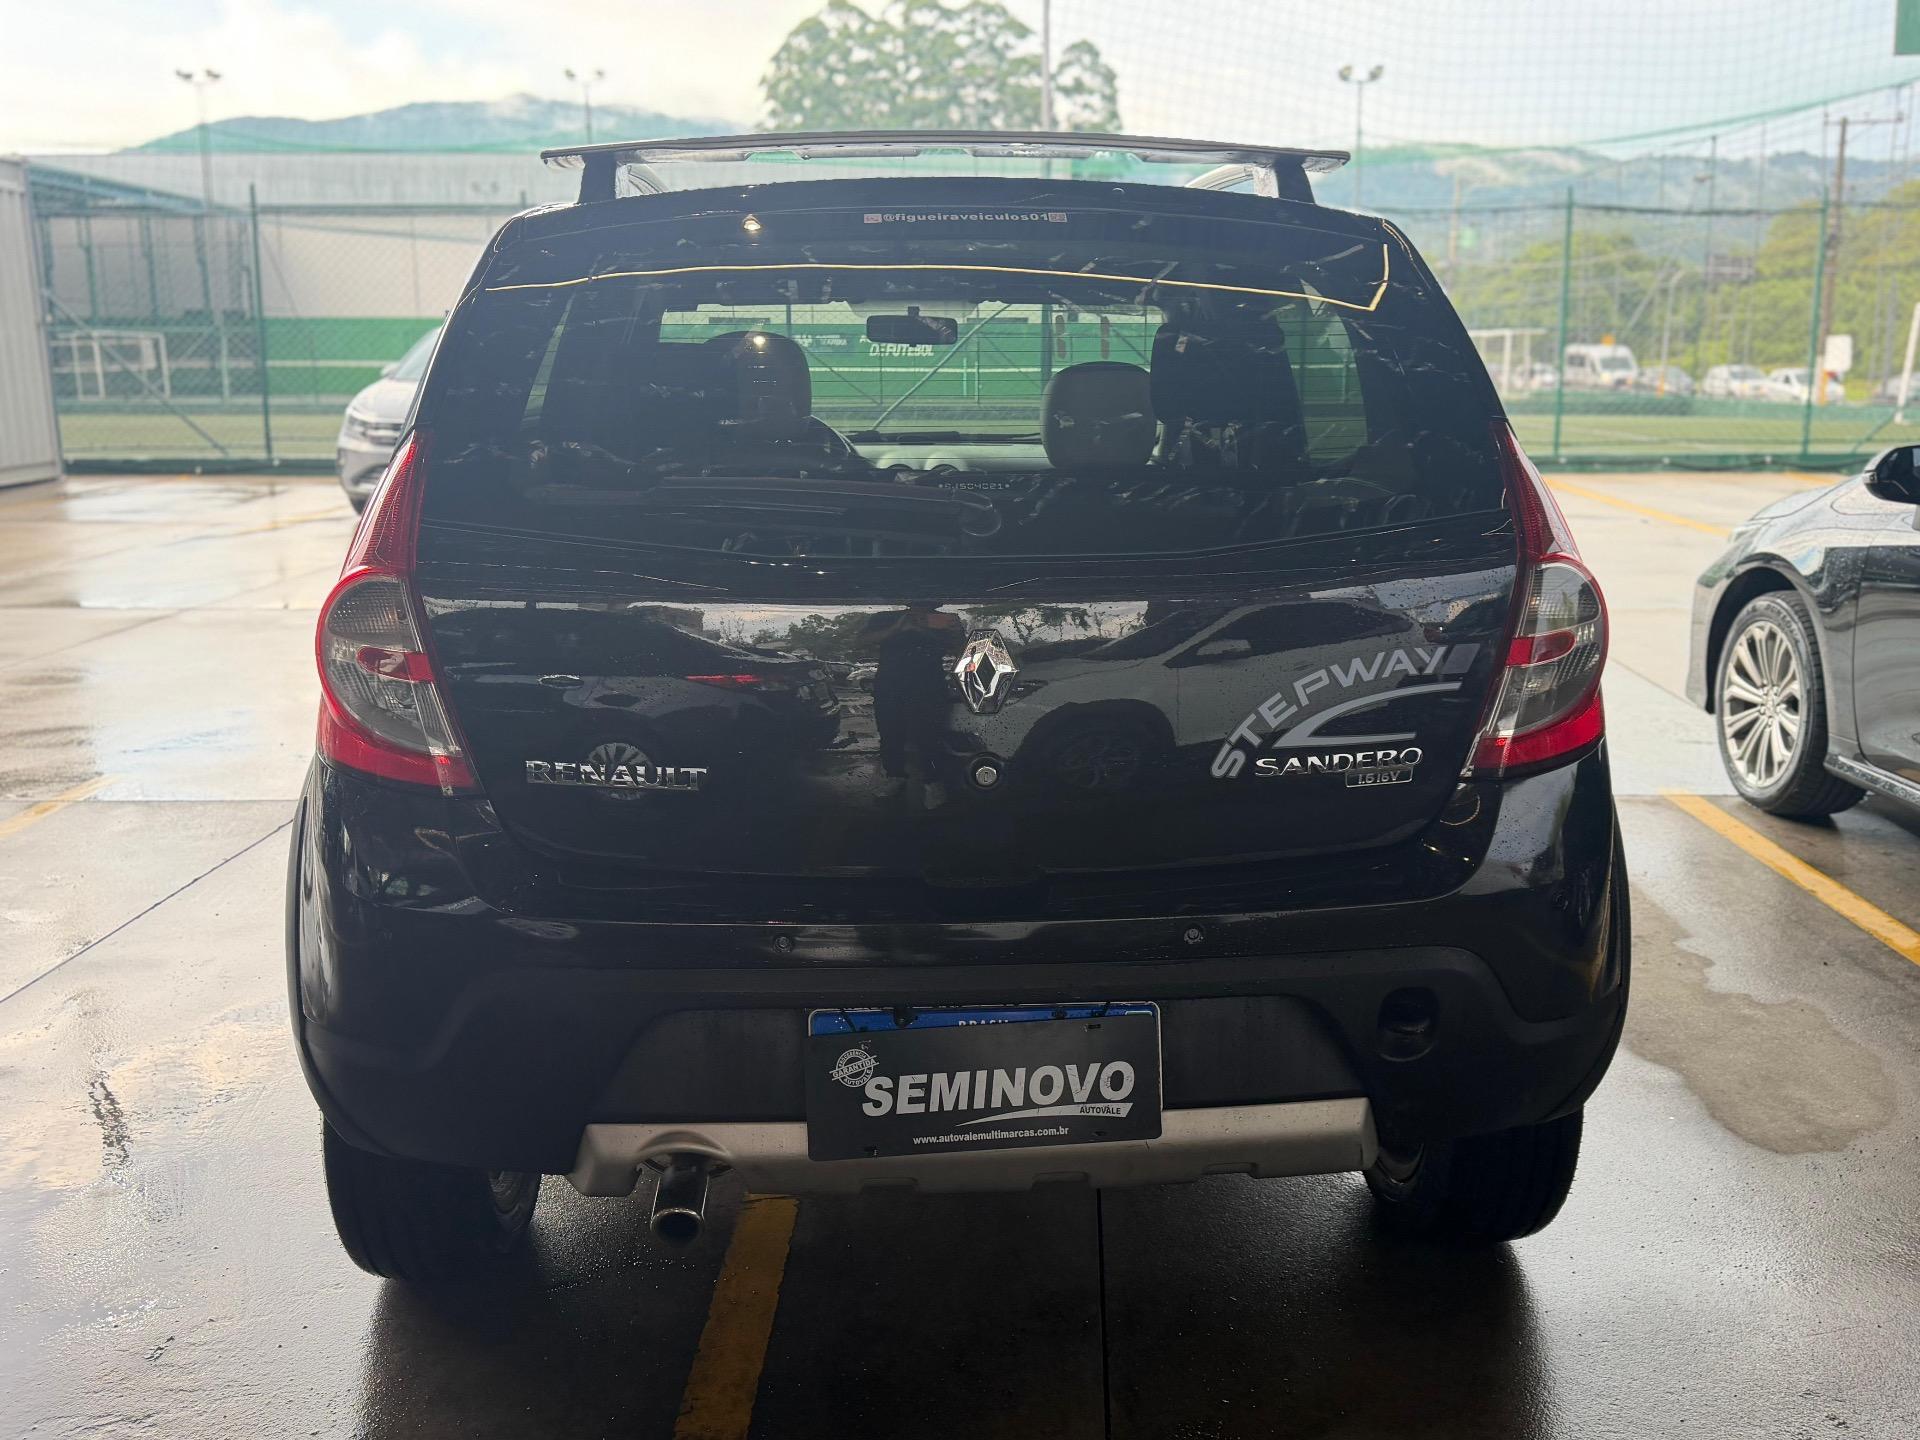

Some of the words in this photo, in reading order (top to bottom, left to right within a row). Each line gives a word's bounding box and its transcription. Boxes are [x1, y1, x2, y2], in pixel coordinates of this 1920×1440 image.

[883, 212, 1049, 223] @figueiraveiculos01
[1210, 646, 1449, 778] STEPWAY
[1255, 747, 1423, 777] SANDERO
[525, 760, 708, 791] RENAULT
[832, 1058, 877, 1078] GARANTIDA
[862, 1060, 1135, 1117] SEMINOVO
[1080, 1106, 1121, 1115] AUTOVALE
[913, 1125, 1069, 1144] www.autovalemultimarcas.com.br
